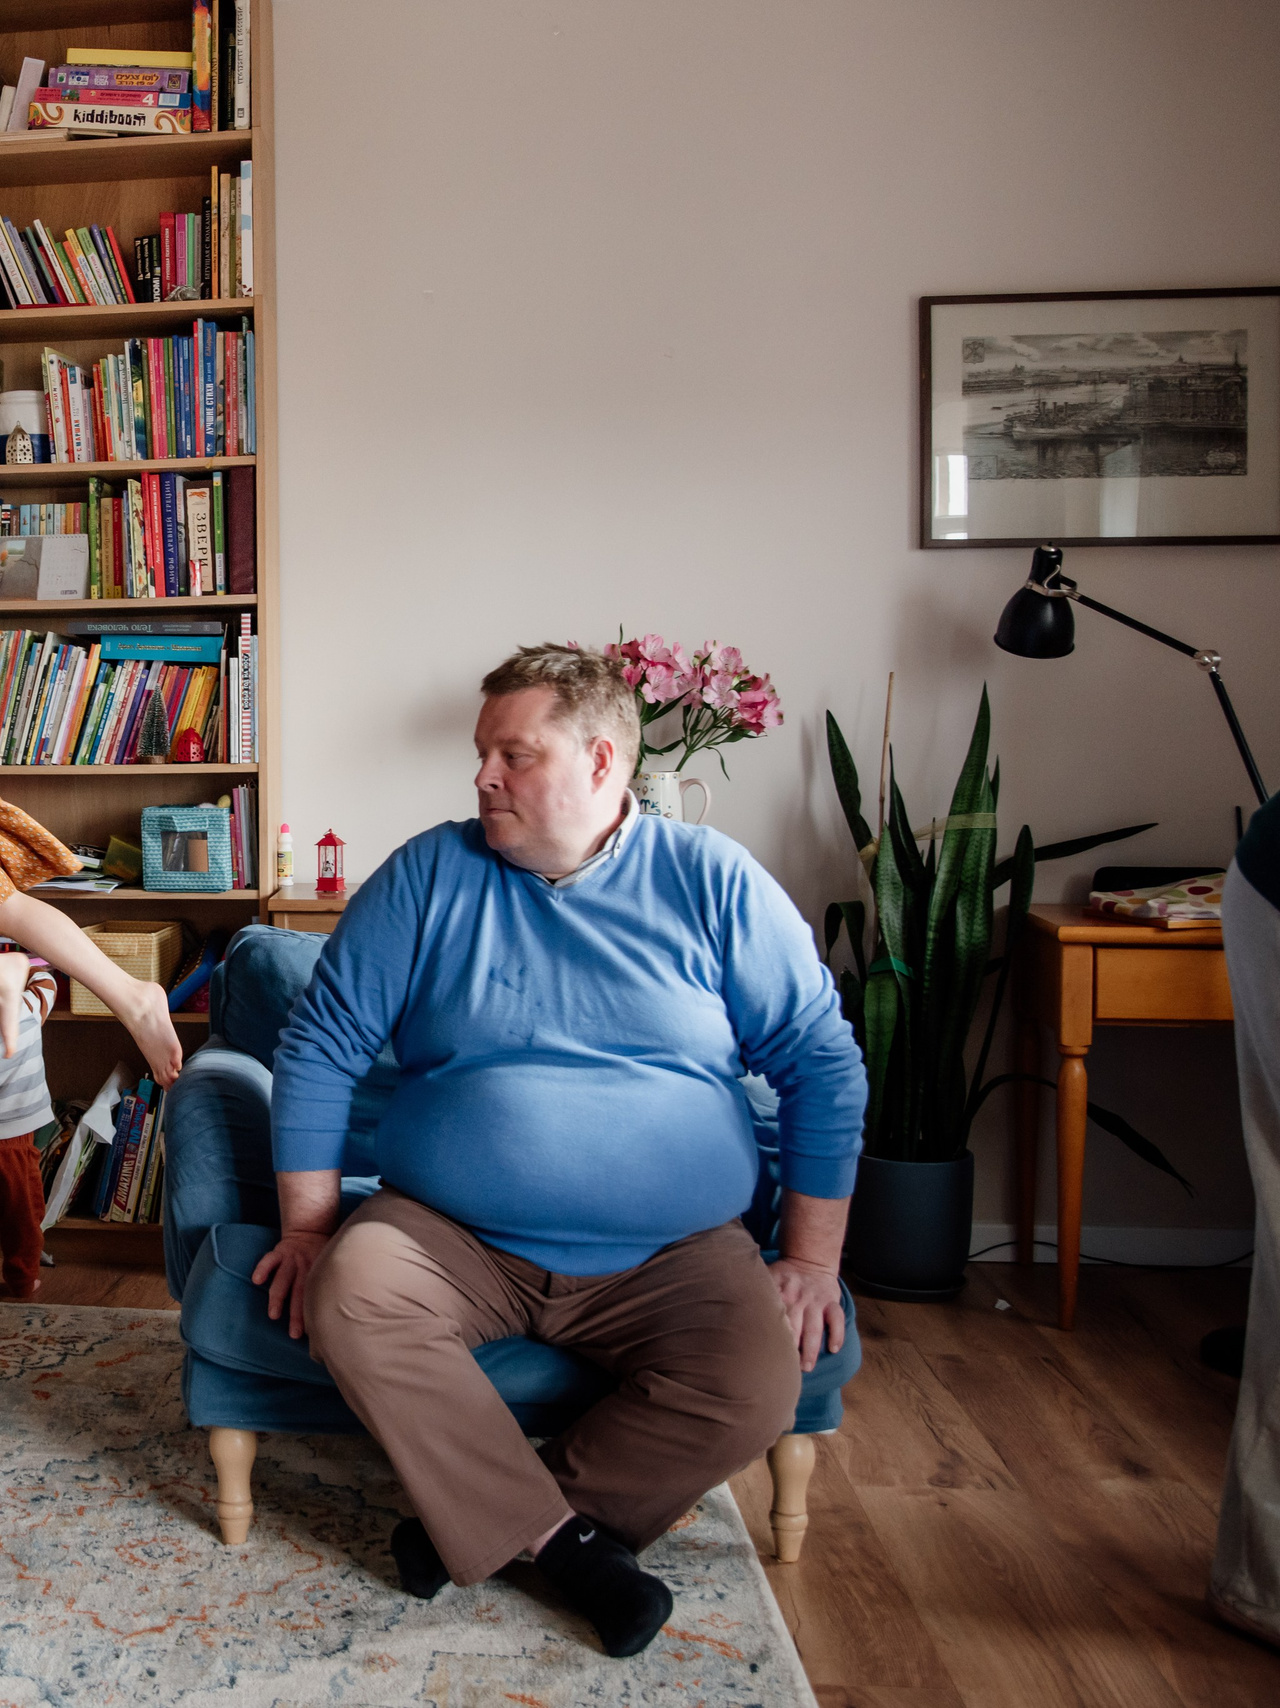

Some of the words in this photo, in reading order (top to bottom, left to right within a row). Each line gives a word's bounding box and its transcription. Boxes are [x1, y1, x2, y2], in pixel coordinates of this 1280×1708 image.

[237, 38, 244, 46] IN
[142, 94, 154, 106] 4
[73, 109, 146, 127] kiddiboom
[205, 383, 214, 406] СТИХИ
[205, 407, 214, 435] ЛУЧШИЕ
[164, 480, 172, 513] ГРЕЦИИ
[164, 517, 174, 553] ДРЕВНЕЙ
[196, 512, 209, 567] ЗВЕРИ
[167, 557, 175, 584] МИФЫ
[87, 624, 129, 633] человека
[131, 624, 153, 633] Тело
[243, 669, 249, 677] НА
[115, 1159, 135, 1206] AMAZING
